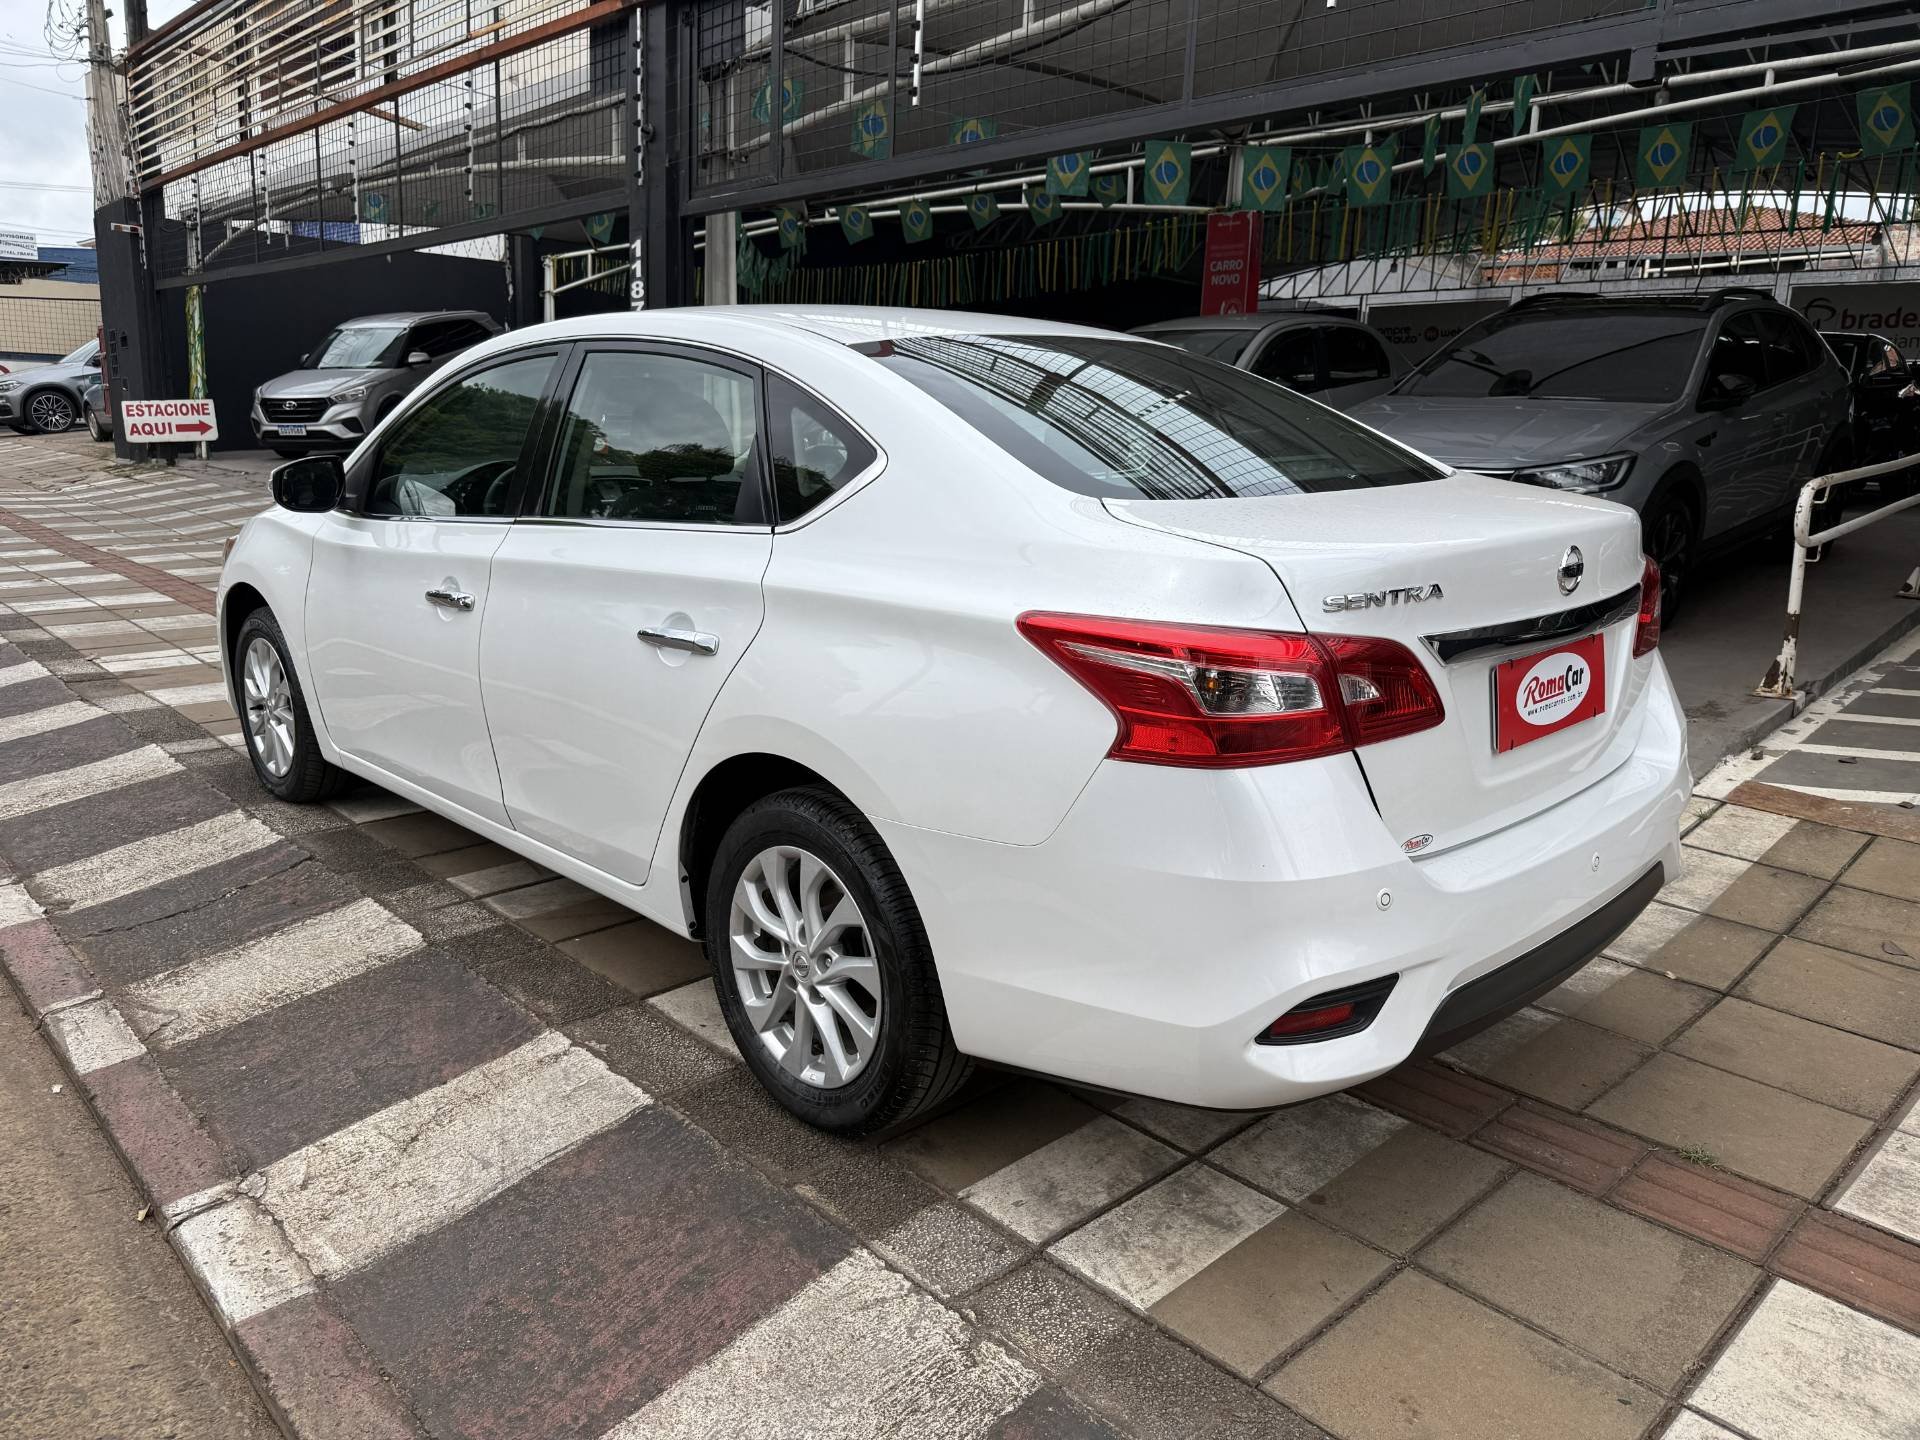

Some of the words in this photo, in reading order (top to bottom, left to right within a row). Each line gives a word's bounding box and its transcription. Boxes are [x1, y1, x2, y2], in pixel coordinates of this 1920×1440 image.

[1209, 259, 1244, 272] CARRO
[1210, 273, 1241, 286] NOVO
[1841, 306, 1920, 329] brade
[125, 403, 210, 417] ESTACIONE
[129, 422, 173, 436] AQUI
[1322, 583, 1444, 613] SENTRA
